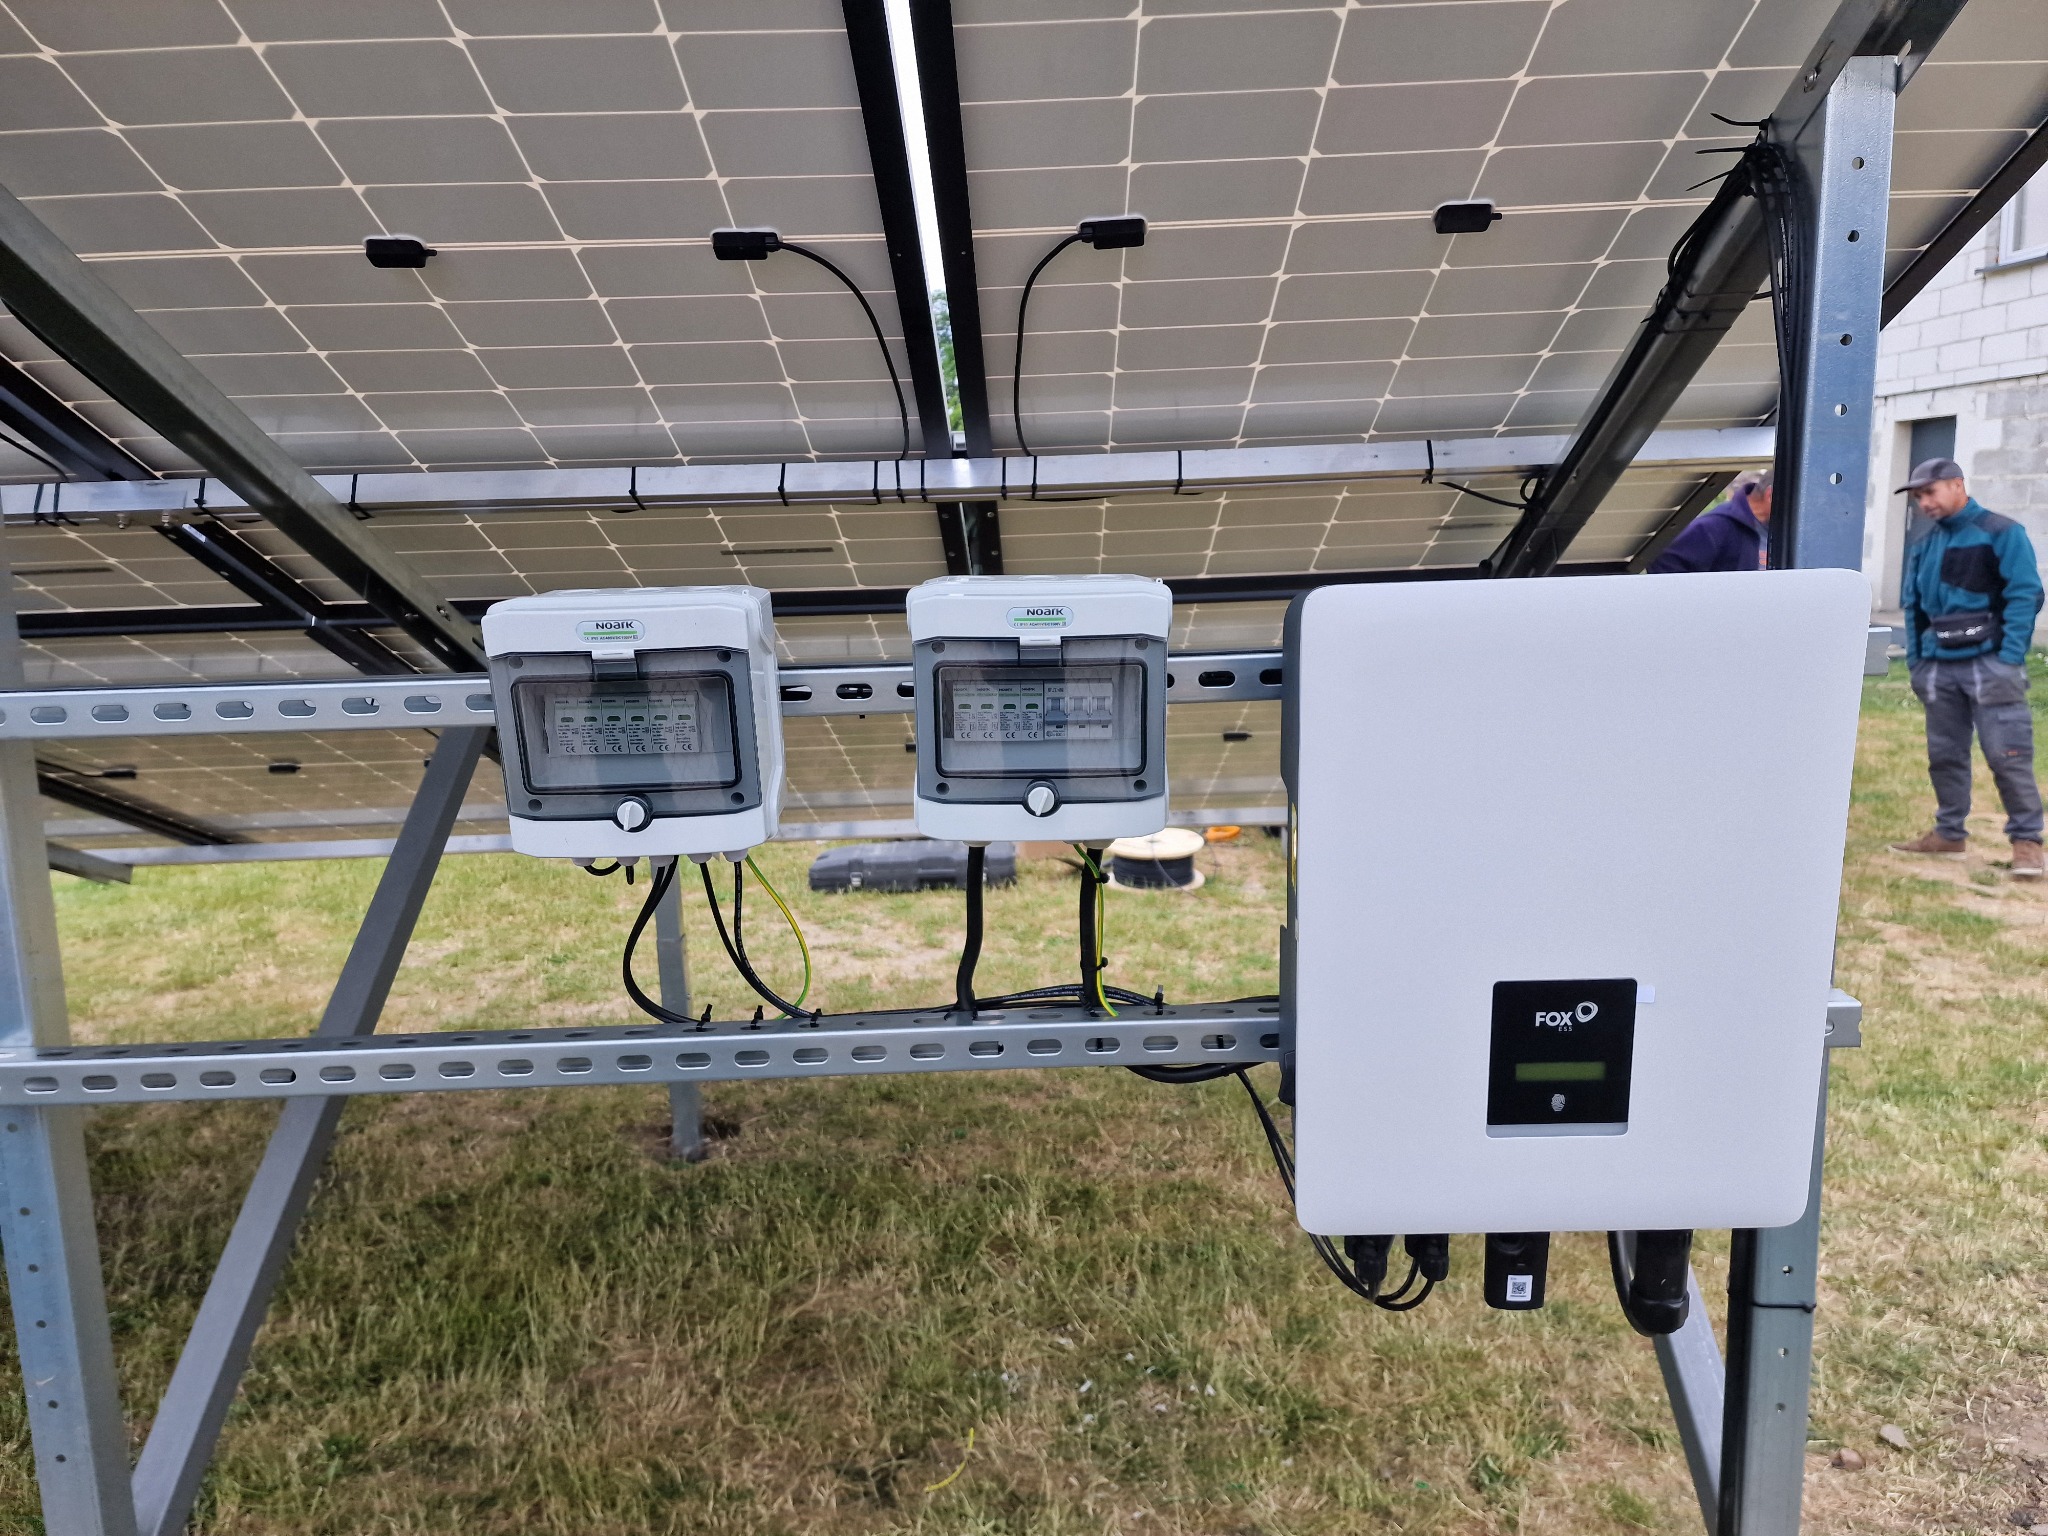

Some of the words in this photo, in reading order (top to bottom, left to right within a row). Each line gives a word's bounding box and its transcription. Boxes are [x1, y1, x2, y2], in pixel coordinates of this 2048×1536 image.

[961, 731, 971, 739] CE
[983, 731, 994, 739] CE
[1005, 731, 1016, 739] CE
[1027, 731, 1038, 739] CE
[589, 745, 599, 753] CE
[612, 745, 623, 753] CE
[635, 744, 646, 752] CE
[658, 744, 670, 752] CE
[682, 743, 693, 751] CE
[1535, 1011, 1573, 1027] FOX
